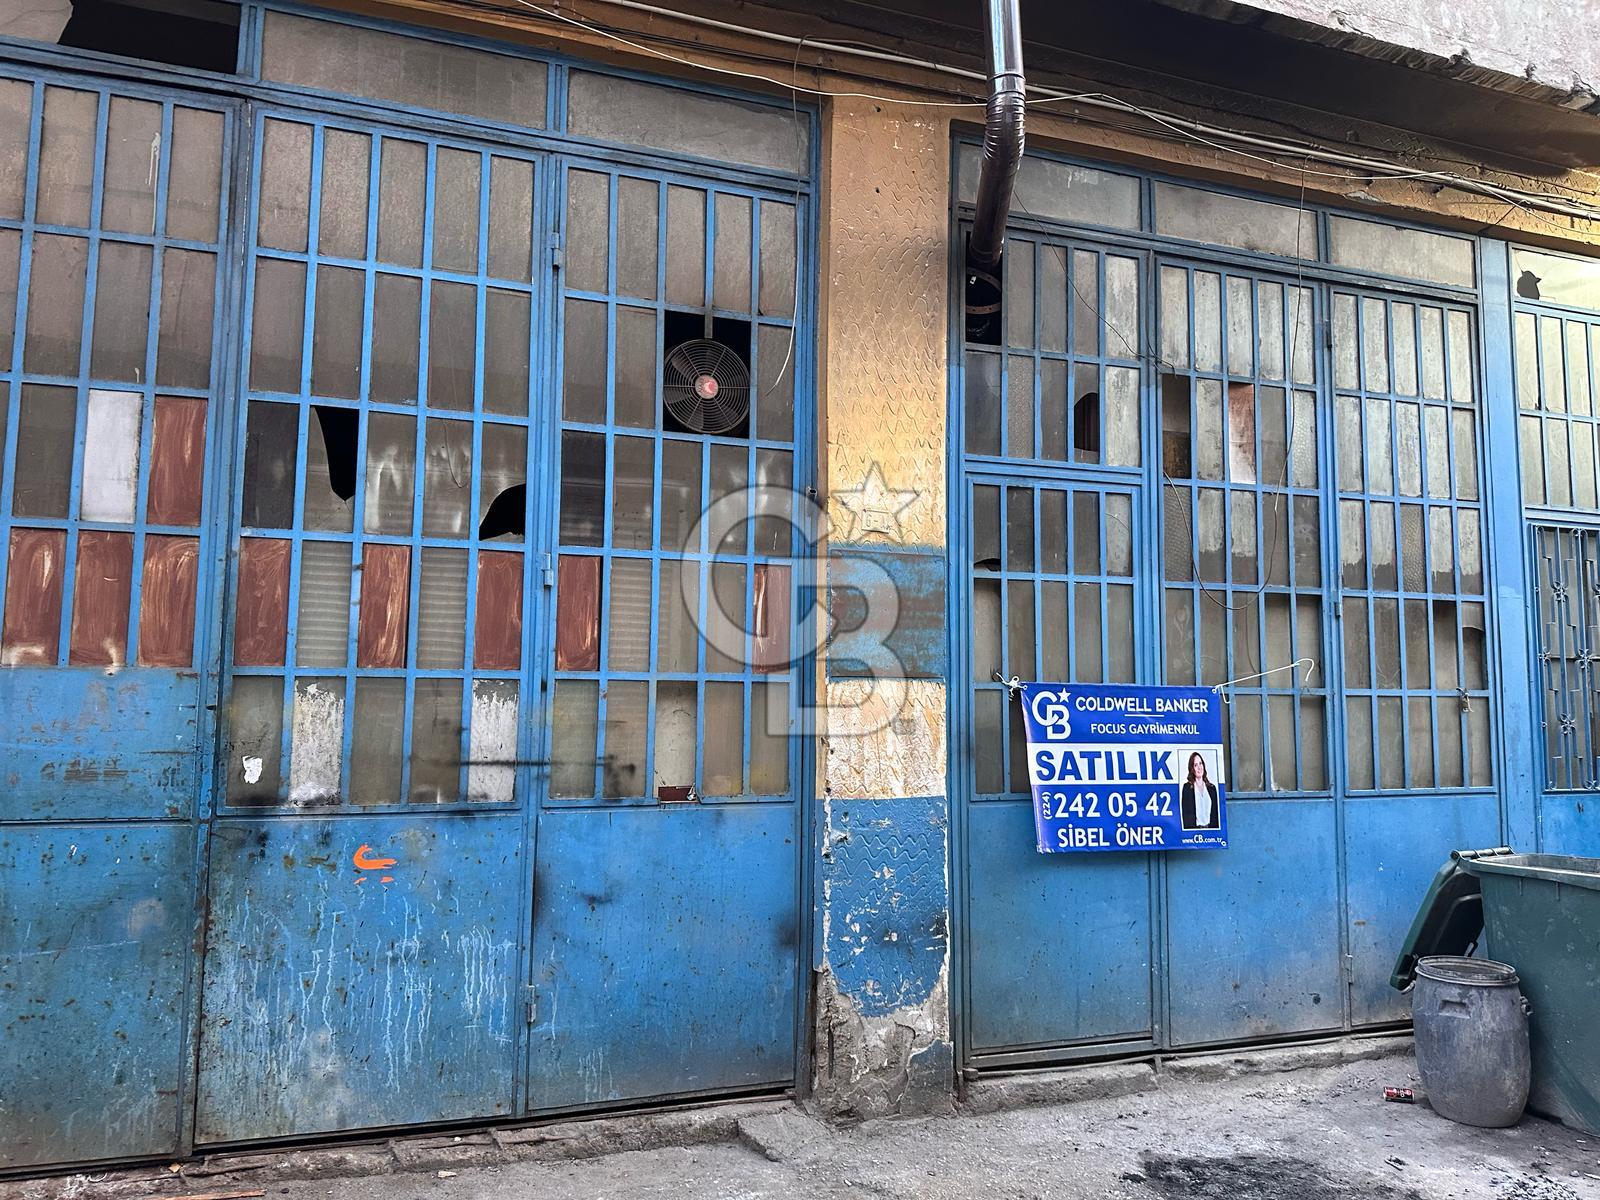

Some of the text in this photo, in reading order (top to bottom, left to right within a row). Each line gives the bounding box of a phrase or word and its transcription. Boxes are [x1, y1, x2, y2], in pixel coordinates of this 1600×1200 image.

[1031, 691, 1071, 740] CB
[1075, 696, 1209, 713] COLDWELL BANKER
[1090, 721, 1200, 735] FOCUS GAYRİMENKUL
[1035, 750, 1174, 781] SATILIK
[1042, 791, 1173, 820] (224) 242 05 42
[1057, 822, 1165, 848] SİBEL ÖNER
